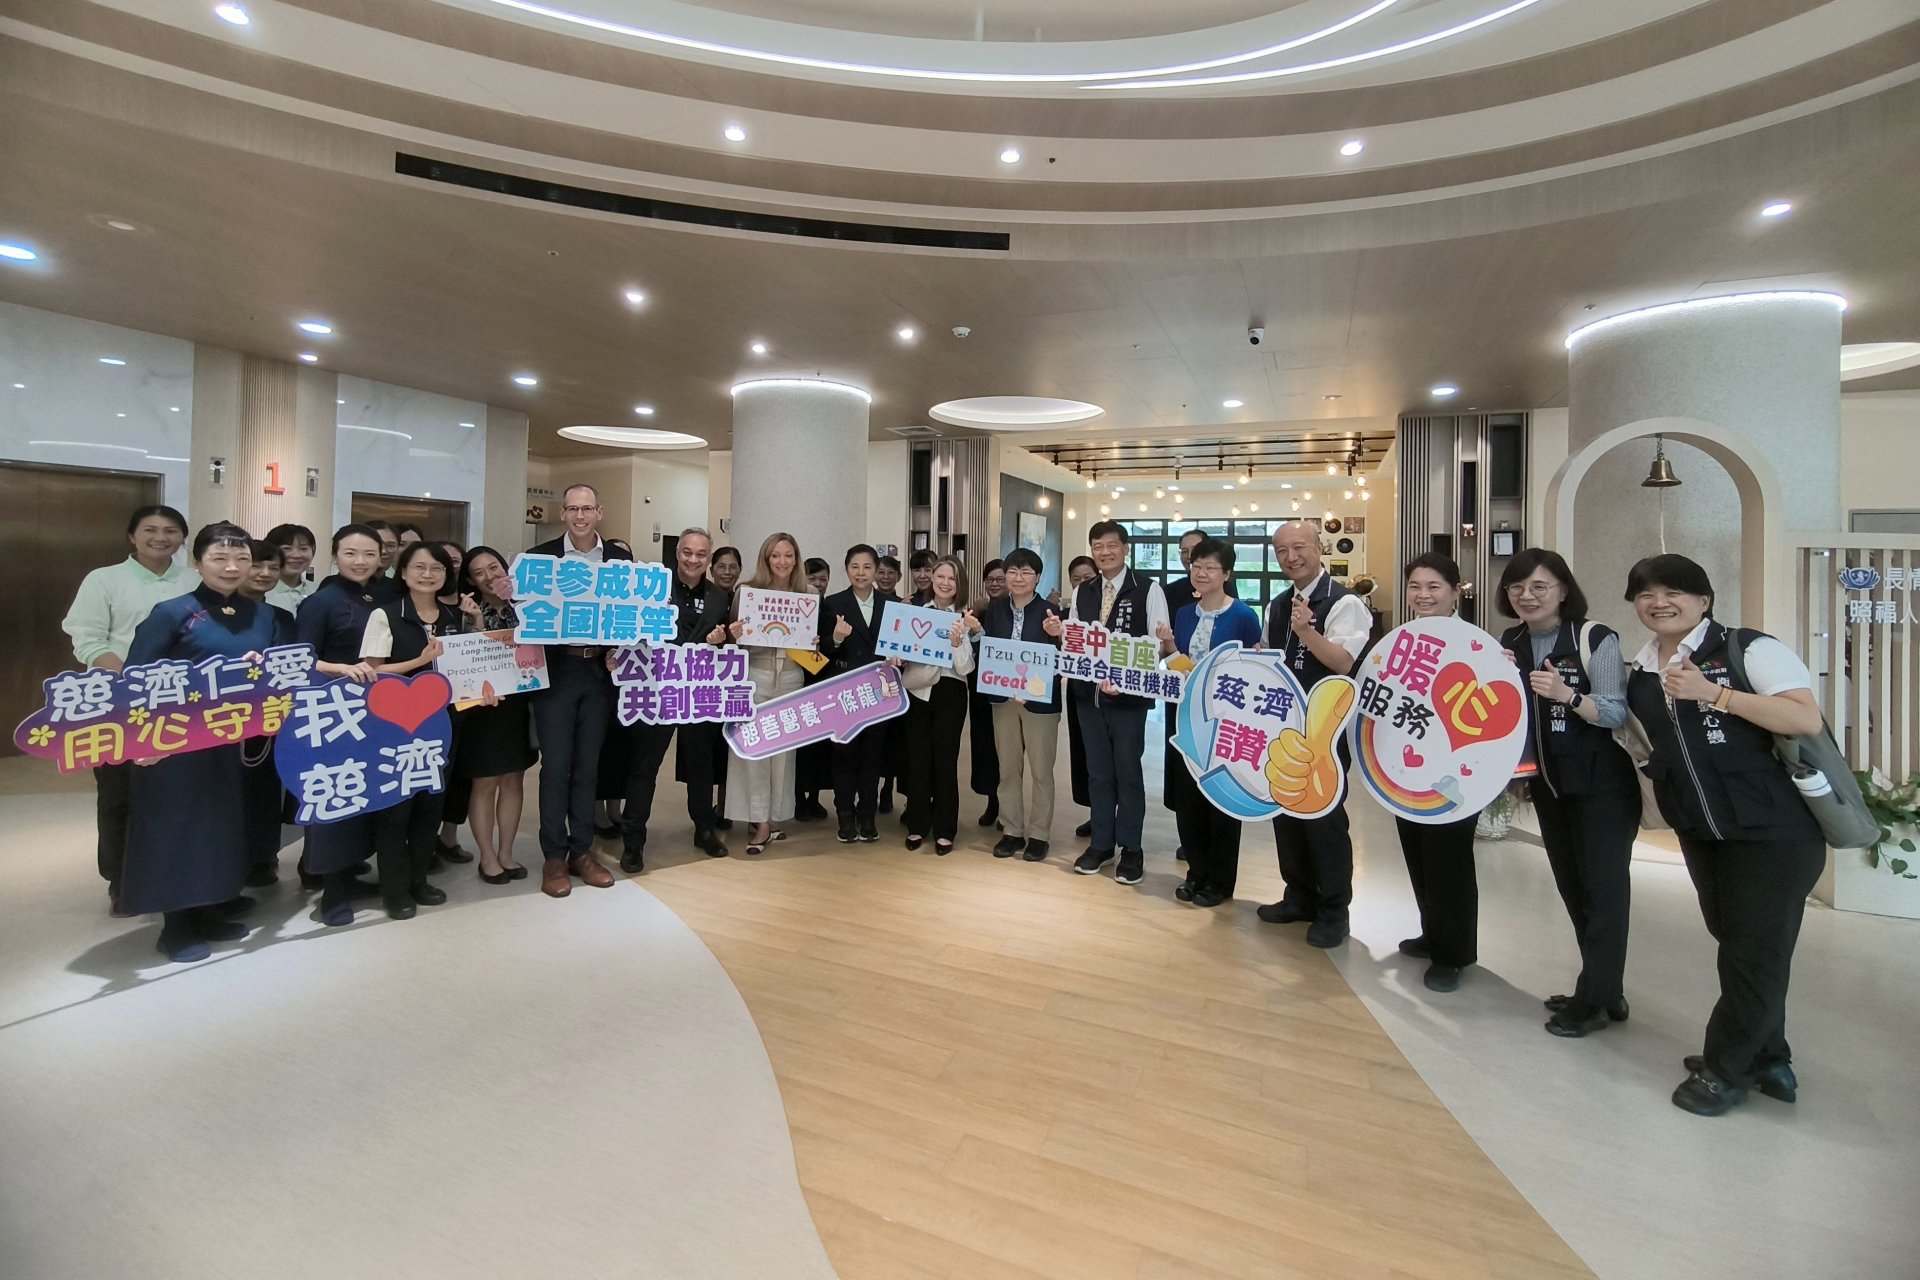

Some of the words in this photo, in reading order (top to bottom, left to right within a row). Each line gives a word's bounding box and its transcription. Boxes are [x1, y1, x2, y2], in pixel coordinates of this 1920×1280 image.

[264, 463, 285, 495] 1
[515, 558, 667, 600] 促參成功
[520, 601, 674, 641] 全國標竿
[758, 604, 800, 615] HEARTED
[761, 613, 800, 623] SERVICE
[893, 618, 901, 632] I
[463, 639, 476, 647] Chi
[472, 653, 514, 663] Institution
[878, 640, 912, 653] TZU
[922, 648, 953, 660] CHI
[984, 645, 1013, 661] Tzu
[1020, 650, 1048, 666] Chi
[1065, 623, 1156, 671] 臺中首座
[447, 664, 487, 676] Protect
[491, 661, 515, 671] with
[518, 659, 540, 668] love
[617, 648, 745, 682] 公私協力
[981, 670, 1028, 690] Great
[50, 647, 315, 722] 慈濟仁愛
[1213, 674, 1295, 722] 慈濟
[294, 684, 368, 748] 我
[623, 685, 752, 721] 共創雙贏
[741, 683, 879, 747] 慈善醫養一條龍
[1358, 677, 1435, 740] 服務
[1216, 719, 1267, 771] 讚
[299, 738, 445, 821] 慈濟
